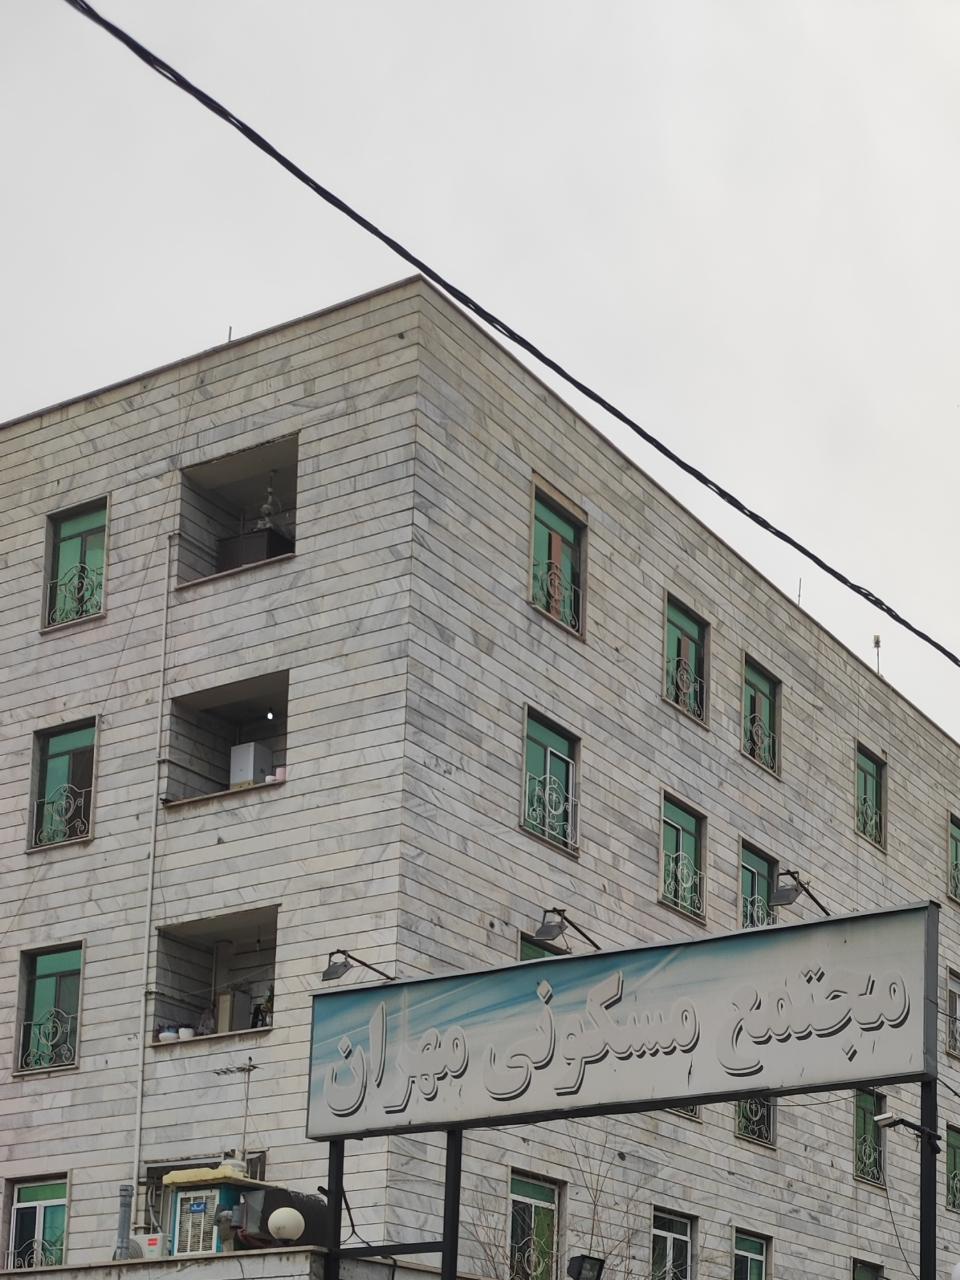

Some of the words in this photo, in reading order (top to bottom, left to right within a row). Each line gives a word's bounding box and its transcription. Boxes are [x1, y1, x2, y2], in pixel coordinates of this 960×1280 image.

[323, 998, 469, 1117] مهران
[484, 969, 700, 1099] مسکونی
[716, 964, 912, 1078] مجتمع
